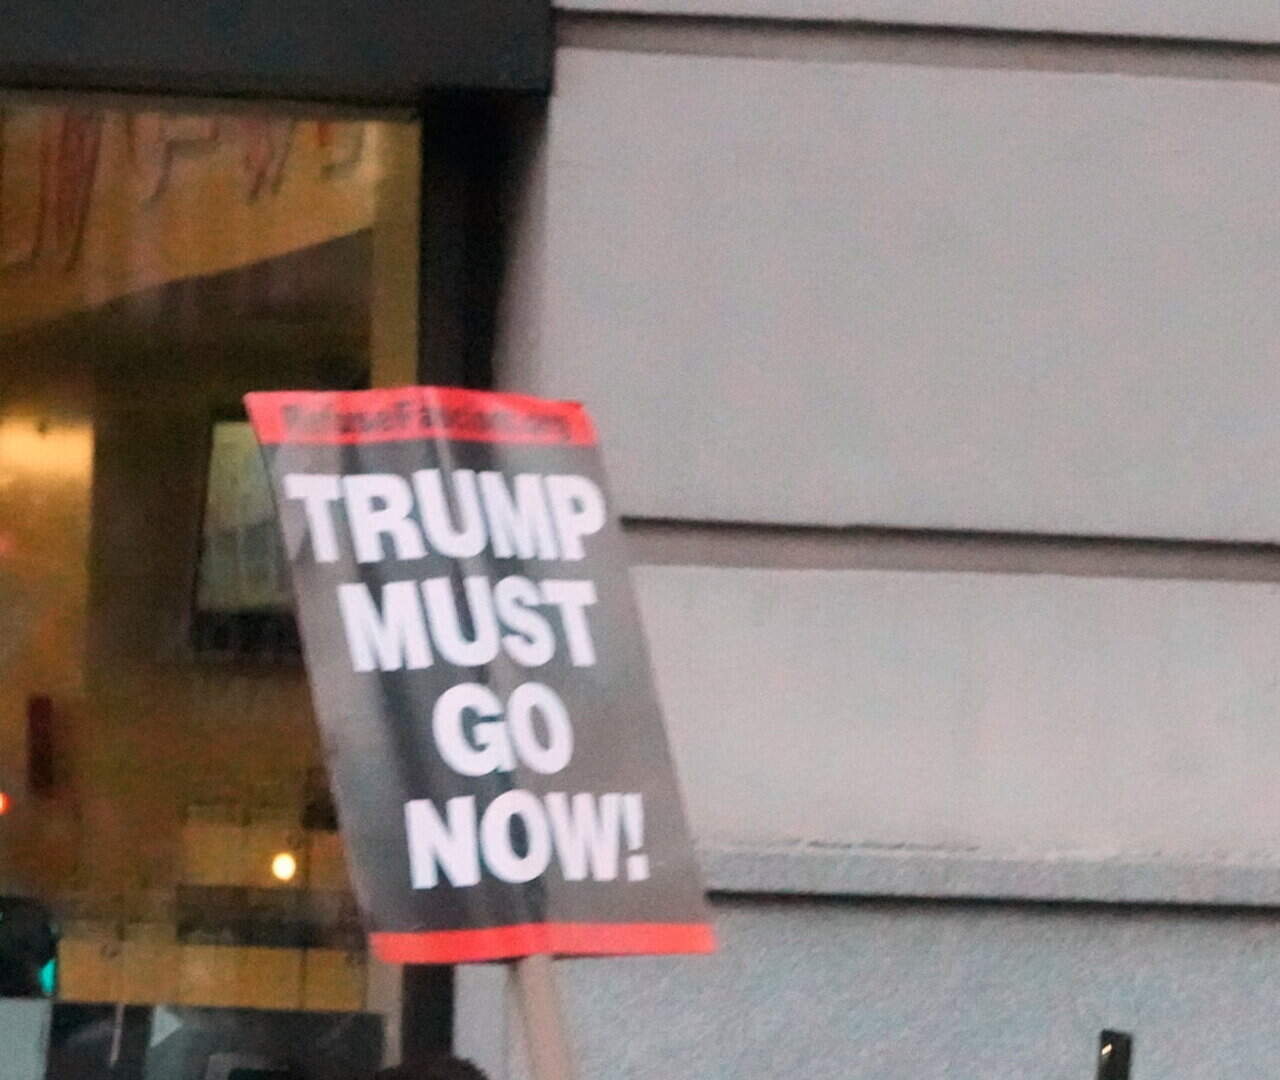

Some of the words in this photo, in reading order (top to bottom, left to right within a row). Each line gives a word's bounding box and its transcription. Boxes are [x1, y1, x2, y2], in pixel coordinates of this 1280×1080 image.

[284, 468, 606, 562] TRUMP
[339, 575, 597, 672] MUST
[432, 682, 574, 776] GO
[404, 788, 651, 889] NOW!
